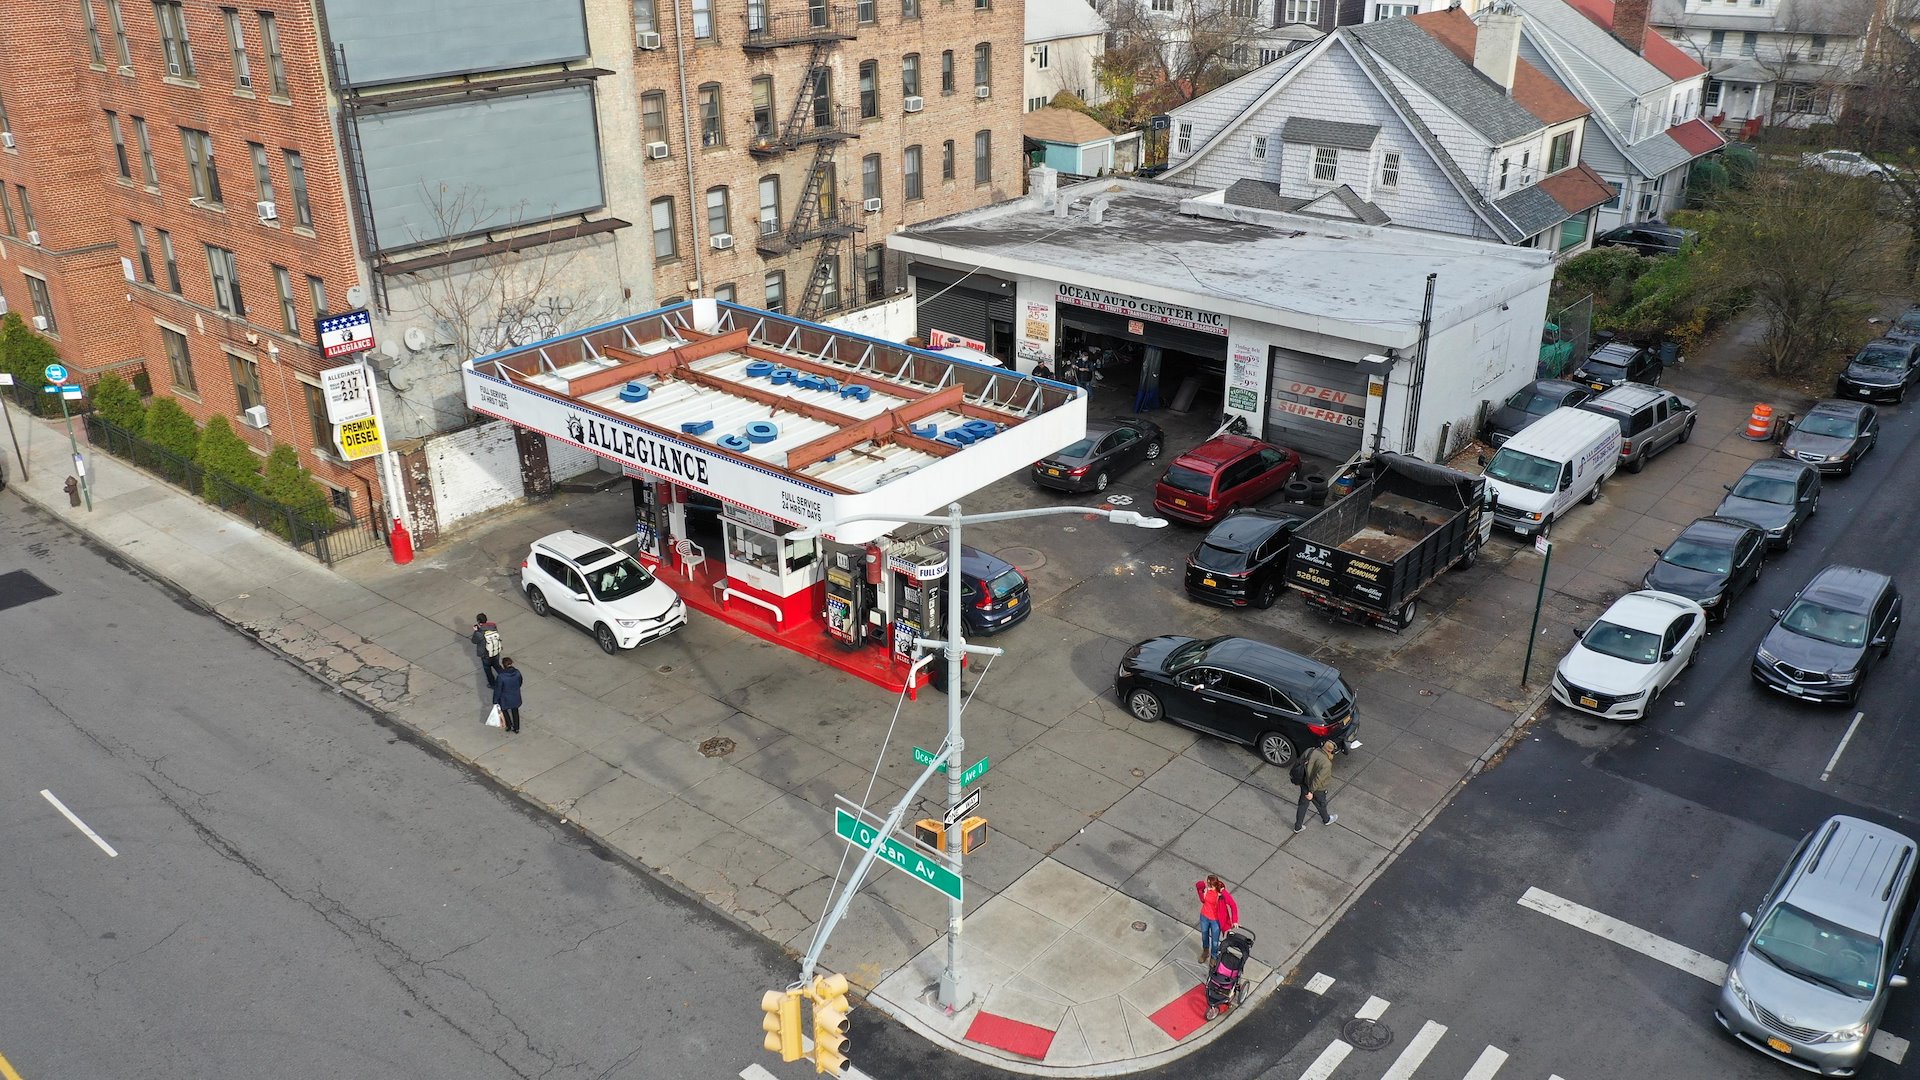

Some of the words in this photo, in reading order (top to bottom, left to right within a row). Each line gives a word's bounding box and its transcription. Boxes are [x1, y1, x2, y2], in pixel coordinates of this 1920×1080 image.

[1059, 284, 1100, 302] OCEAN
[1103, 295, 1137, 309] AUTO
[1141, 303, 1193, 321] CENTER
[1197, 312, 1224, 327] INC.
[1057, 295, 1076, 304] BRAKES
[1080, 299, 1092, 308] TUNE
[1104, 304, 1122, 313] STRUTS
[1127, 308, 1162, 322] TRANSMISSION
[1167, 317, 1194, 329] COMPUTER
[1194, 322, 1225, 335] DIAGNOSTIC
[328, 338, 371, 356] ALLEGIANCE
[328, 368, 362, 381] ALLEGIANCE
[340, 377, 357, 390] 217
[342, 388, 360, 401] 227
[480, 385, 490, 395] FULL
[490, 389, 508, 401] SERVICE
[1230, 389, 1257, 400] REGISTERED
[1290, 382, 1347, 403] OPEN
[498, 399, 509, 410] DAYS
[1279, 400, 1343, 424] SUN-FRI
[1346, 415, 1353, 426] 8
[342, 419, 377, 434] PREMIUM
[345, 430, 378, 447] DIESEL
[588, 419, 709, 486] ALLEGIANCE
[781, 491, 795, 504] FULL
[796, 496, 821, 512] SERVICE
[781, 500, 789, 509] 24
[806, 509, 822, 522] DAYS
[1296, 552, 1325, 565] Solutions
[1304, 544, 1317, 555] P
[1318, 548, 1331, 560] F
[919, 567, 935, 577] FULL
[1348, 559, 1382, 573] RUBBISH
[1345, 567, 1378, 582] REMOVAL
[915, 749, 936, 766] Ocea
[964, 770, 977, 783] Ave
[947, 811, 959, 823] ONE
[965, 795, 978, 808] WAY
[915, 860, 935, 880] Av
